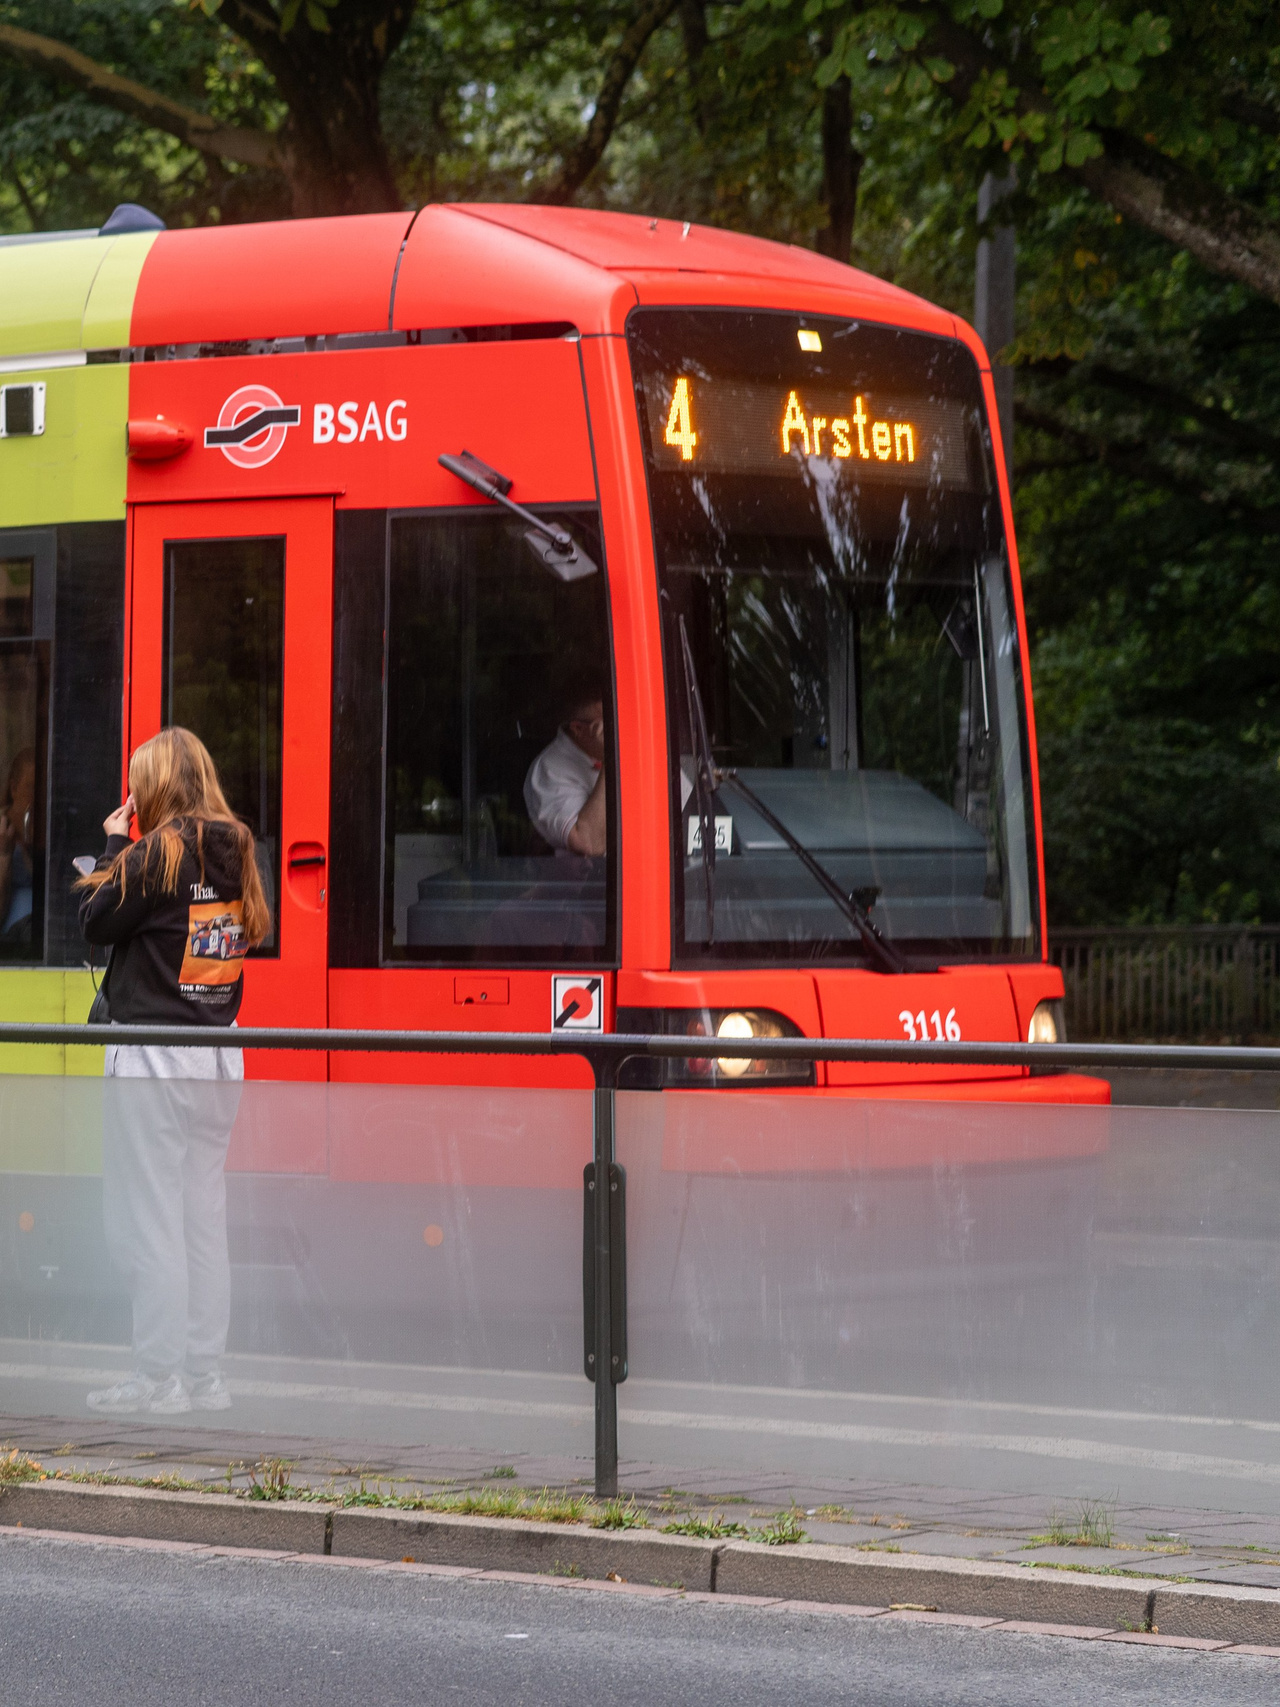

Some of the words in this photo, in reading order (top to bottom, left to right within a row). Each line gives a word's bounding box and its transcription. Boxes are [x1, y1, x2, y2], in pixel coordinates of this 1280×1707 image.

[313, 399, 408, 444] BSAG
[664, 377, 697, 462] 4
[782, 390, 916, 463] Arsten
[692, 825, 726, 846] 45
[898, 1007, 961, 1041] 3116
